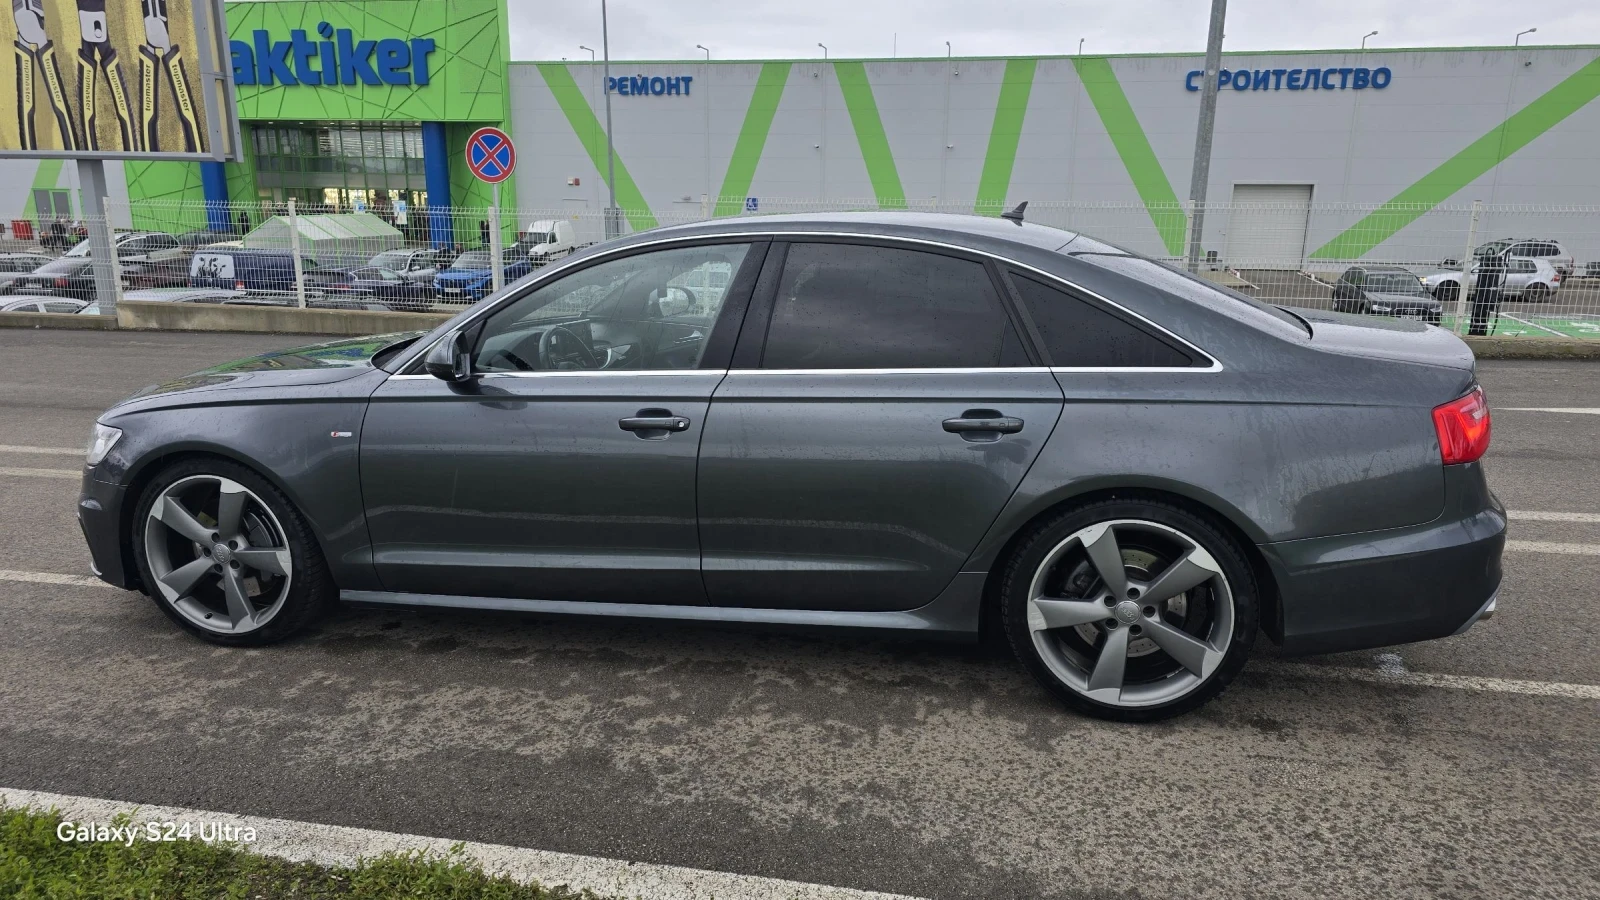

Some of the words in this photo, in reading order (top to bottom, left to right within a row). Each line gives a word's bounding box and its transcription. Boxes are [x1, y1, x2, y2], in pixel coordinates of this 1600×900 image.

[45, 58, 62, 103] topmaster
[110, 69, 126, 112] topmaster
[172, 64, 191, 112] topmaster
[604, 76, 693, 96] РЕМОНТ
[1185, 67, 1392, 91] СРОИТЕЛСТВО
